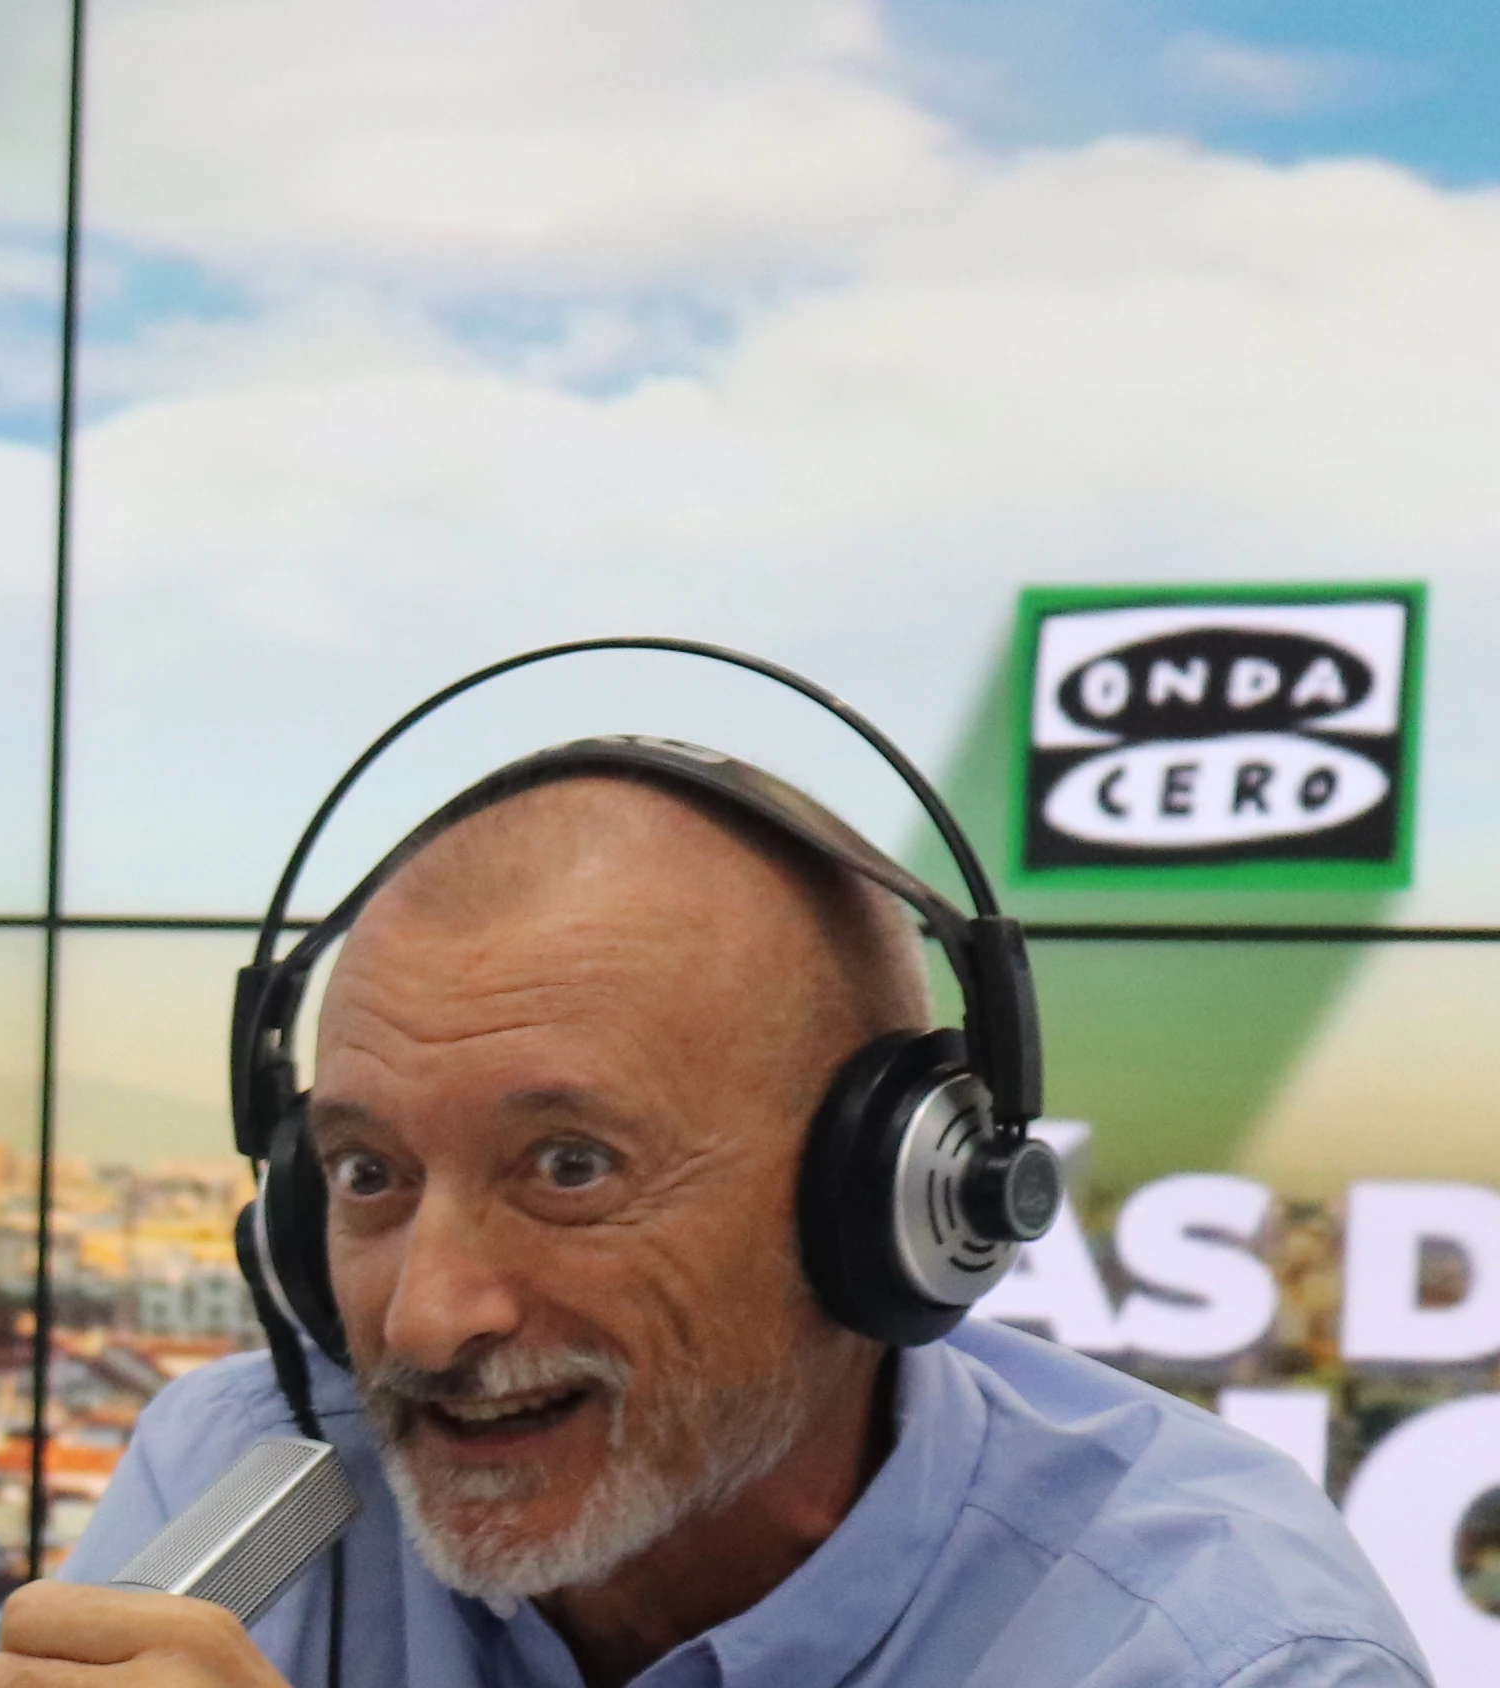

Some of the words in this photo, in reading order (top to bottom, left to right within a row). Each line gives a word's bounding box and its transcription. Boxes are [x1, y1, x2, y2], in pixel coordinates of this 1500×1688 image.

[1079, 655, 1346, 719] ONDA
[1096, 760, 1339, 818] CERO
[968, 1119, 1279, 1359] ÁS
[1338, 1179, 1500, 1363] D
